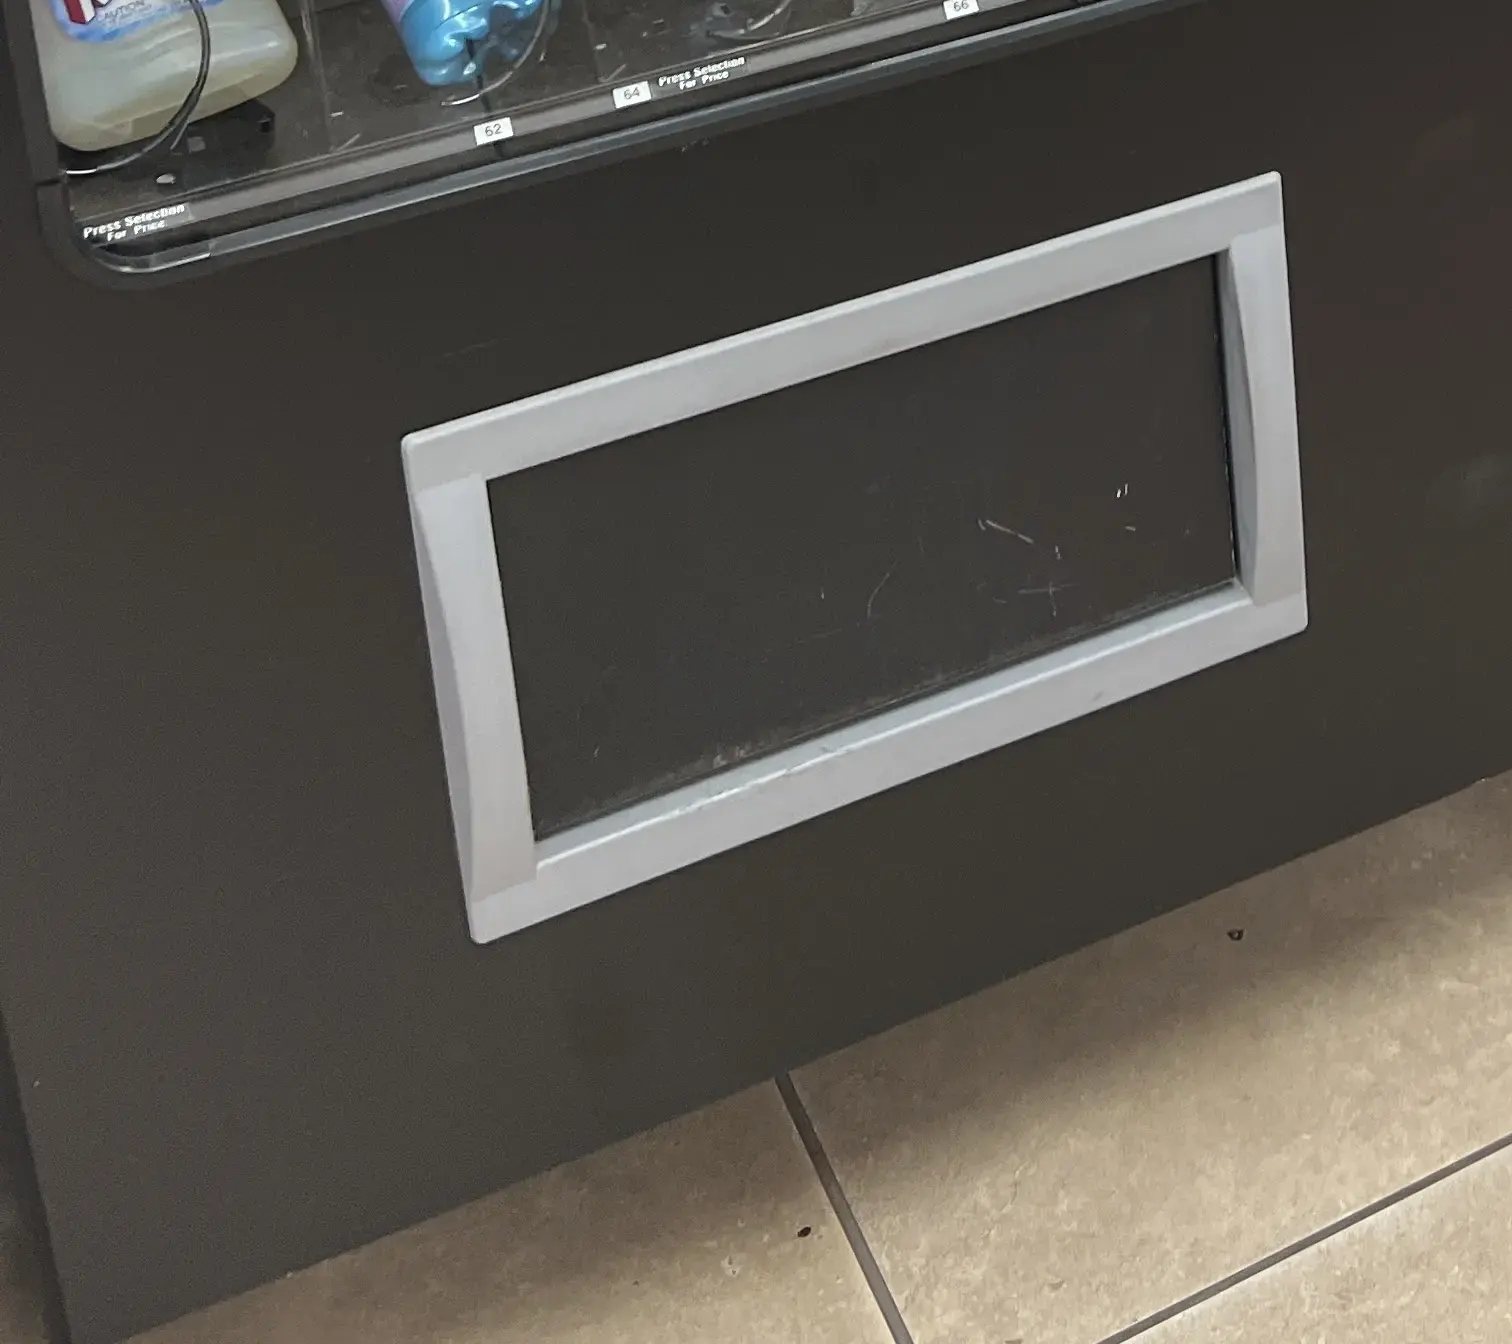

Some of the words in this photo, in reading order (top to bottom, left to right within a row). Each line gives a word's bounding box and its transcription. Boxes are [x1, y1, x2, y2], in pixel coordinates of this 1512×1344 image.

[953, 0, 969, 11] 66
[623, 88, 639, 100] 64
[659, 71, 691, 87] Press
[694, 57, 745, 75] Selection
[679, 79, 697, 91] For
[703, 71, 728, 83] Price
[484, 123, 502, 136] 62
[83, 221, 121, 239] Press
[124, 204, 184, 228] Selection
[107, 227, 127, 242] For
[134, 219, 166, 233] Price
